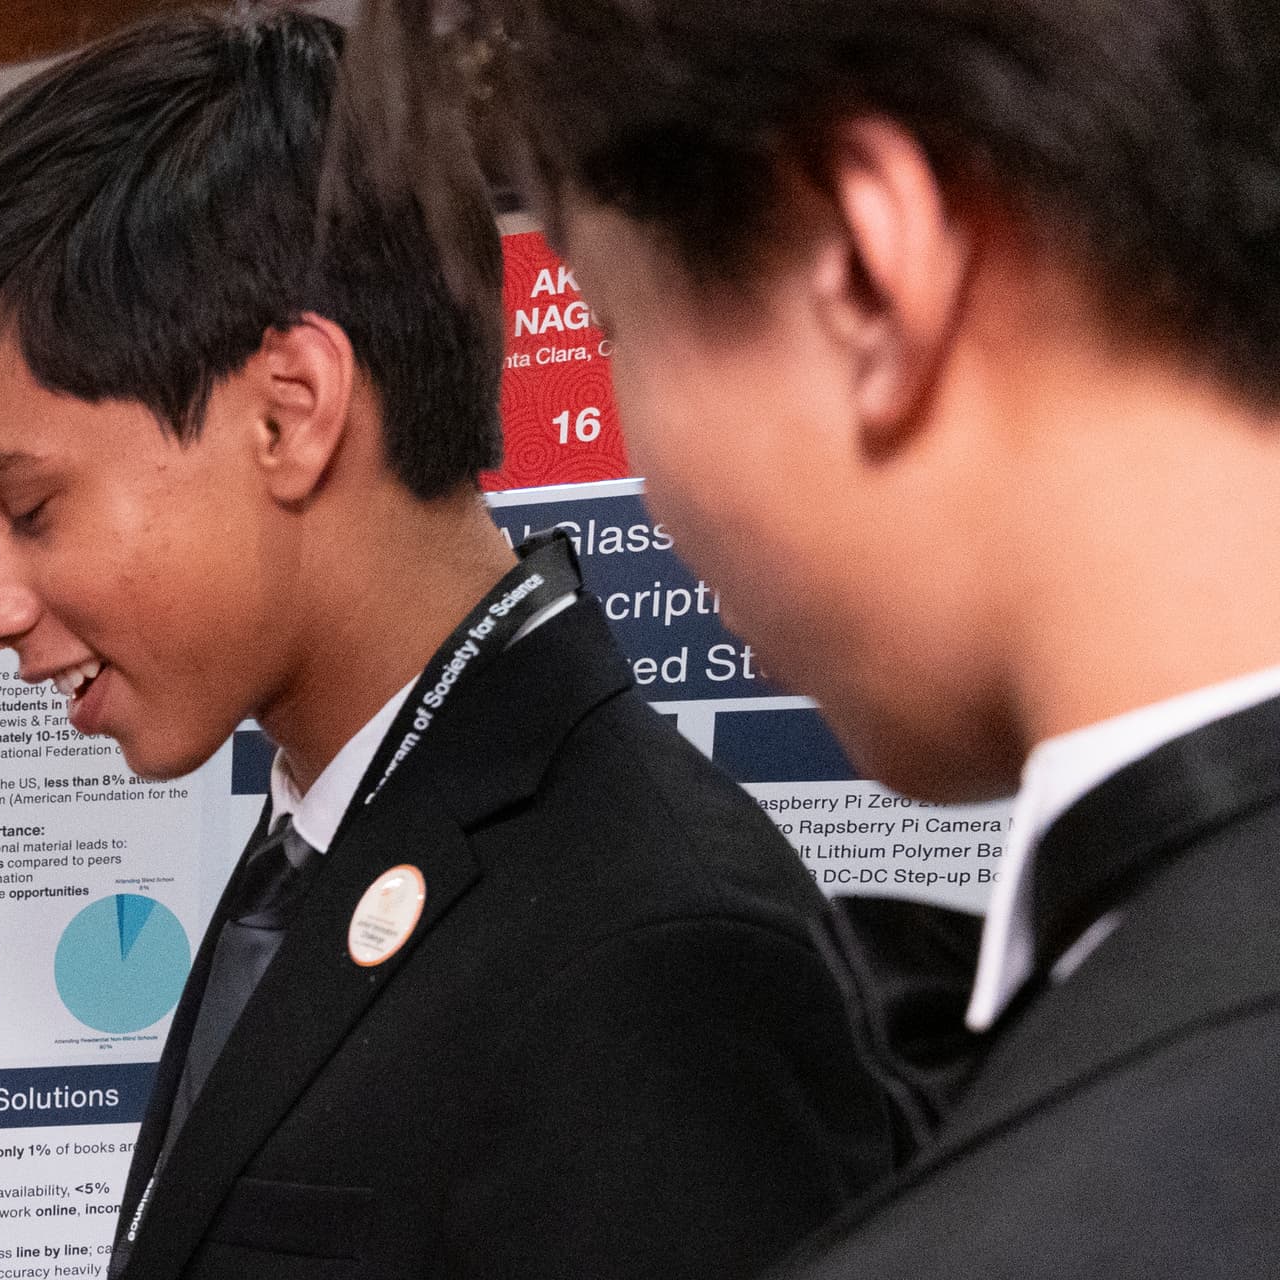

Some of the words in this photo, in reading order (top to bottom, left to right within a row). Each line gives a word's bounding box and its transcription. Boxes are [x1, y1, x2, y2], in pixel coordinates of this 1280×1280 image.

[536, 346, 592, 365] Clara,
[552, 406, 602, 444] 16
[413, 706, 433, 730] of
[423, 640, 479, 708] Society
[468, 615, 496, 640] for
[489, 574, 545, 617] Science
[30, 715, 40, 727] &
[45, 744, 111, 757] Federation
[18, 777, 40, 790] US,
[44, 777, 69, 788] less
[71, 775, 99, 787] than
[102, 774, 125, 786] 8%
[9, 792, 71, 807] (American
[75, 789, 144, 802] Foundation
[148, 788, 165, 799] for
[168, 787, 188, 798] the
[757, 795, 839, 811] aspberry
[844, 794, 862, 809] Pi
[867, 793, 913, 808] Zero
[799, 819, 896, 837] Rapsberry
[901, 818, 919, 833] Pi
[925, 818, 1001, 833] Camera
[22, 839, 72, 852] material
[75, 838, 108, 850] leads
[111, 839, 127, 849] to:
[817, 844, 886, 859] Lithium
[892, 843, 972, 861] Polymer
[7, 855, 68, 870] compared
[87, 855, 122, 867] peers
[823, 868, 888, 883] DC-DC
[893, 868, 971, 886] Step-up
[8, 885, 89, 901] opportunities
[28, 1143, 51, 1156] 1%
[55, 1143, 69, 1155] of
[73, 1141, 115, 1154] books
[74, 1181, 110, 1195] <5%
[35, 1204, 80, 1217] online,
[16, 1246, 40, 1258] line
[44, 1245, 60, 1259] by
[54, 1263, 101, 1277] heavily
